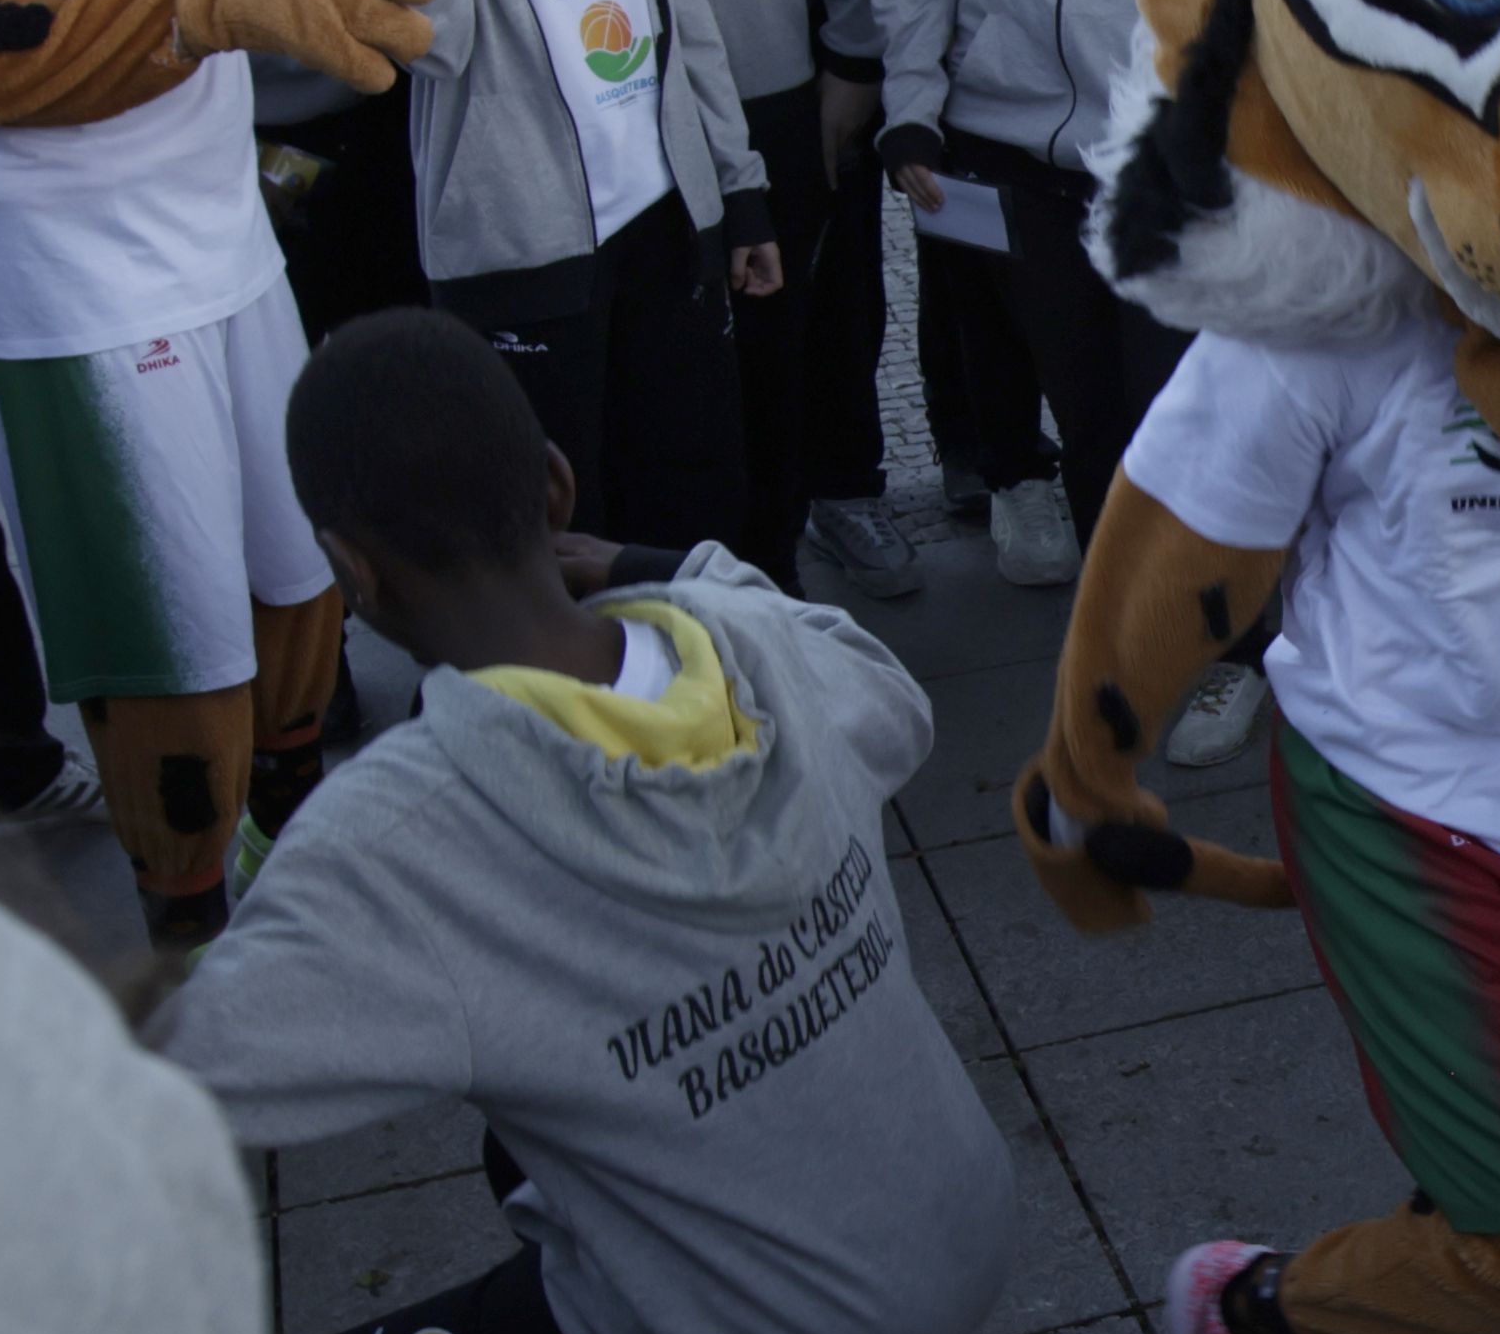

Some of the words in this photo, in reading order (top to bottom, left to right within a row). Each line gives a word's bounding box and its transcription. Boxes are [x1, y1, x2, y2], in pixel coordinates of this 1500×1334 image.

[595, 75, 657, 105] BASQUETEBO
[136, 355, 181, 374] DHIKA
[608, 968, 752, 1081] VIANA
[757, 942, 796, 996] do
[789, 833, 872, 960] CASTELO
[678, 910, 894, 1119] BASQUETEBOL
